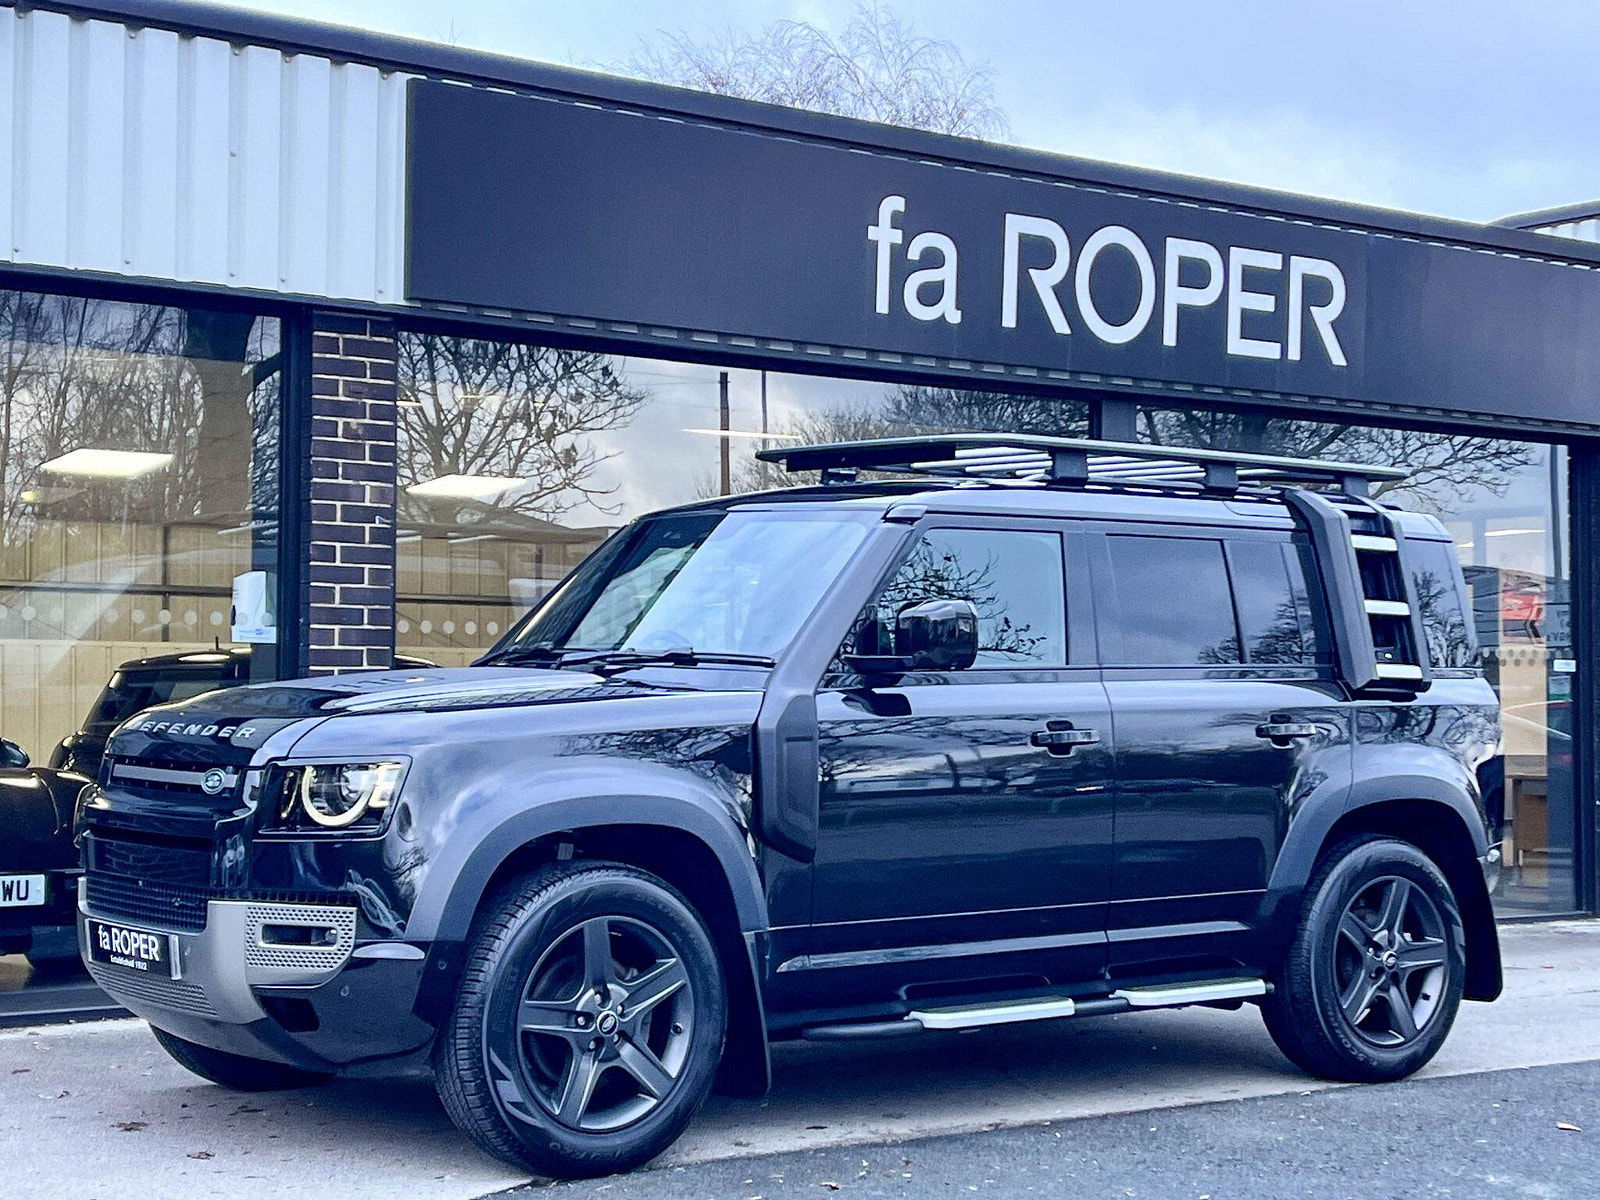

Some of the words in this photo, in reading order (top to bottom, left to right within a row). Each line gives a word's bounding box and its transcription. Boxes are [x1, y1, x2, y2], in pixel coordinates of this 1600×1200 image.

[867, 195, 962, 324] fa
[1001, 212, 1347, 367] ROPER
[2, 879, 29, 902] WU
[98, 924, 111, 951] fa
[111, 927, 160, 962] ROPER
